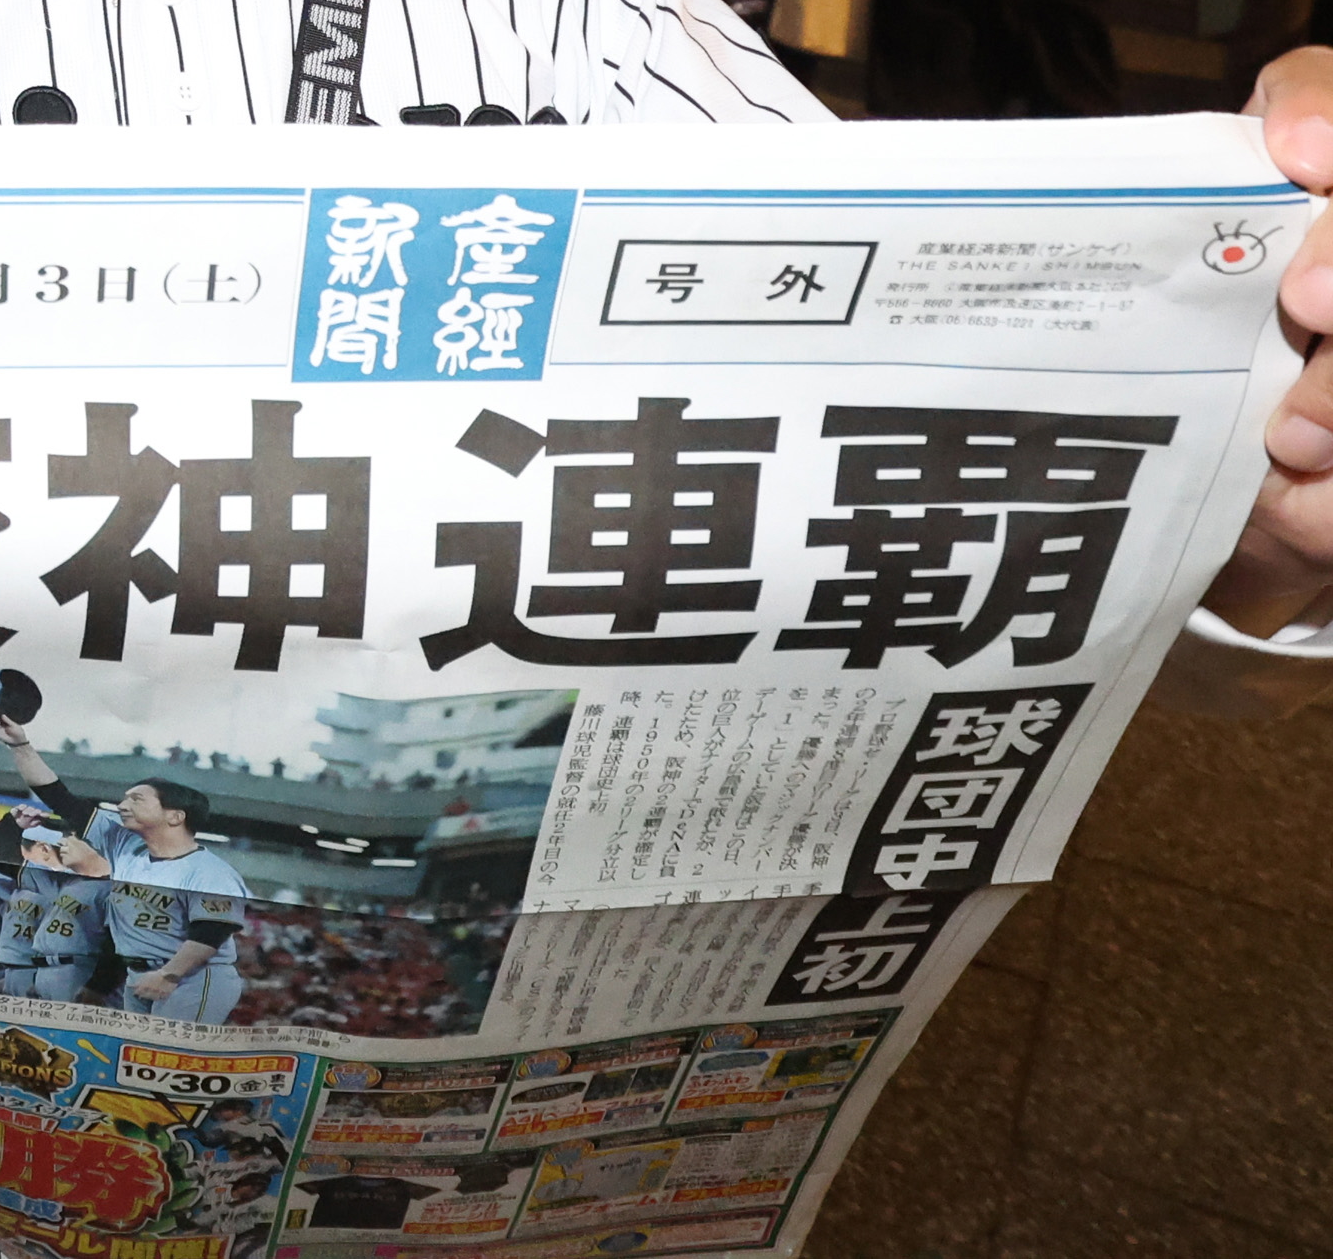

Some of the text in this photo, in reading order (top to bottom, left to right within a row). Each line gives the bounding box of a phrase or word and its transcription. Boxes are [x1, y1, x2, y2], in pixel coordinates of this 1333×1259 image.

[898, 260, 937, 272] THE
[947, 260, 1031, 272] SANKEI
[309, 192, 421, 377] 新聞
[645, 261, 828, 305] 号外
[536, 702, 607, 885] 藤川球児監督の就任2年目の今
[12, 923, 33, 940] 74
[46, 919, 75, 938] 86
[133, 912, 172, 933] 22
[121, 1064, 232, 1096] 10/30
